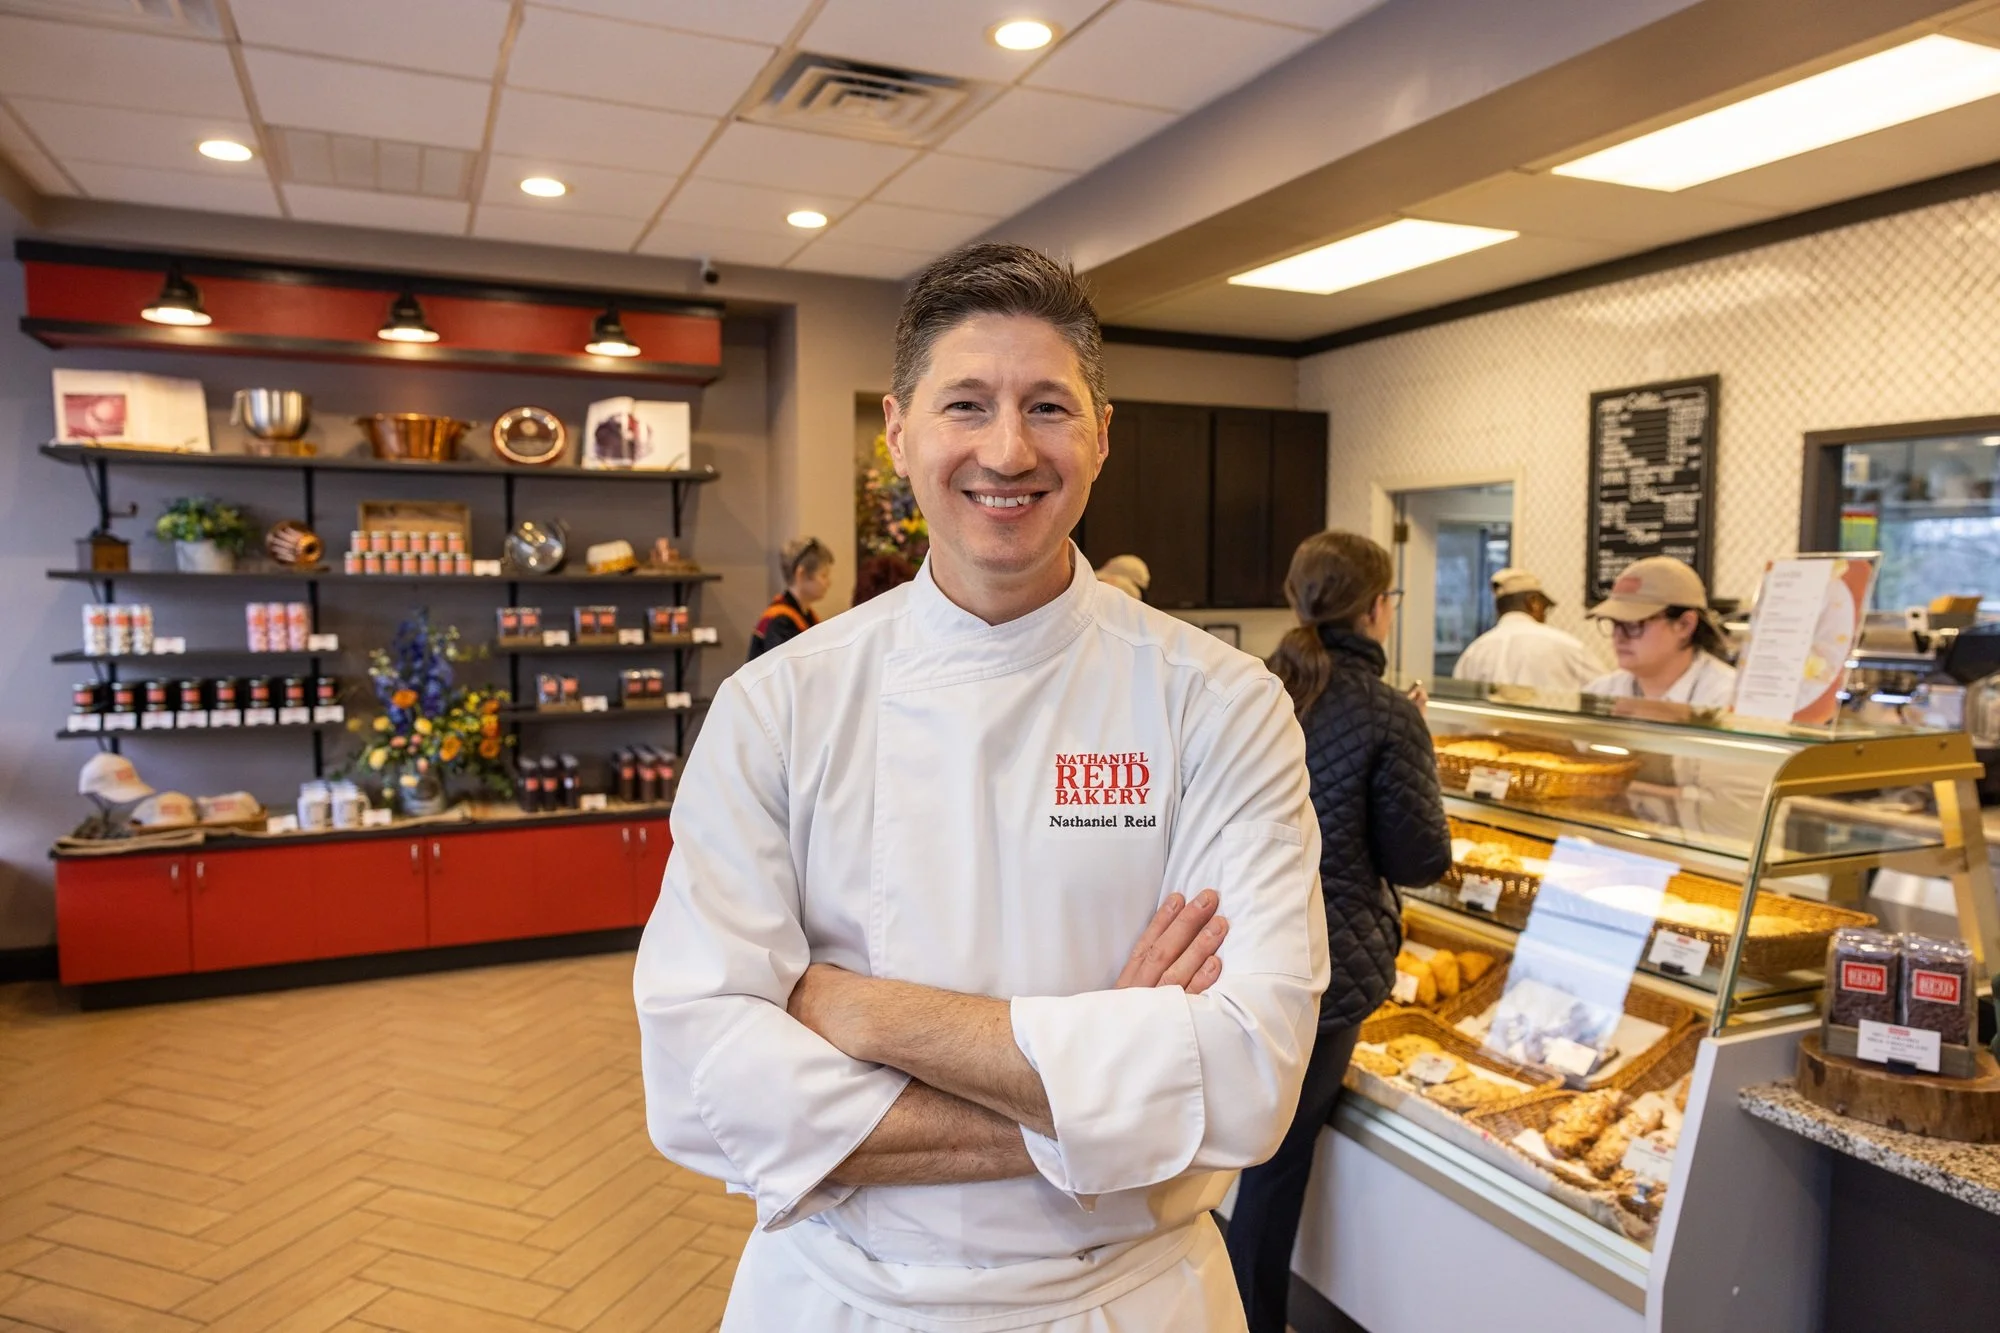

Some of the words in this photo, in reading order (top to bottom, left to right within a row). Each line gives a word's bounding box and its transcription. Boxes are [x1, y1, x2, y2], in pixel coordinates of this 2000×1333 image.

[1055, 752, 1149, 765] NATHANIEL
[1055, 763, 1150, 789] REID
[1055, 788, 1150, 805] BAKERY
[1049, 815, 1117, 828] Nathaniel
[1124, 815, 1156, 828] Reid
